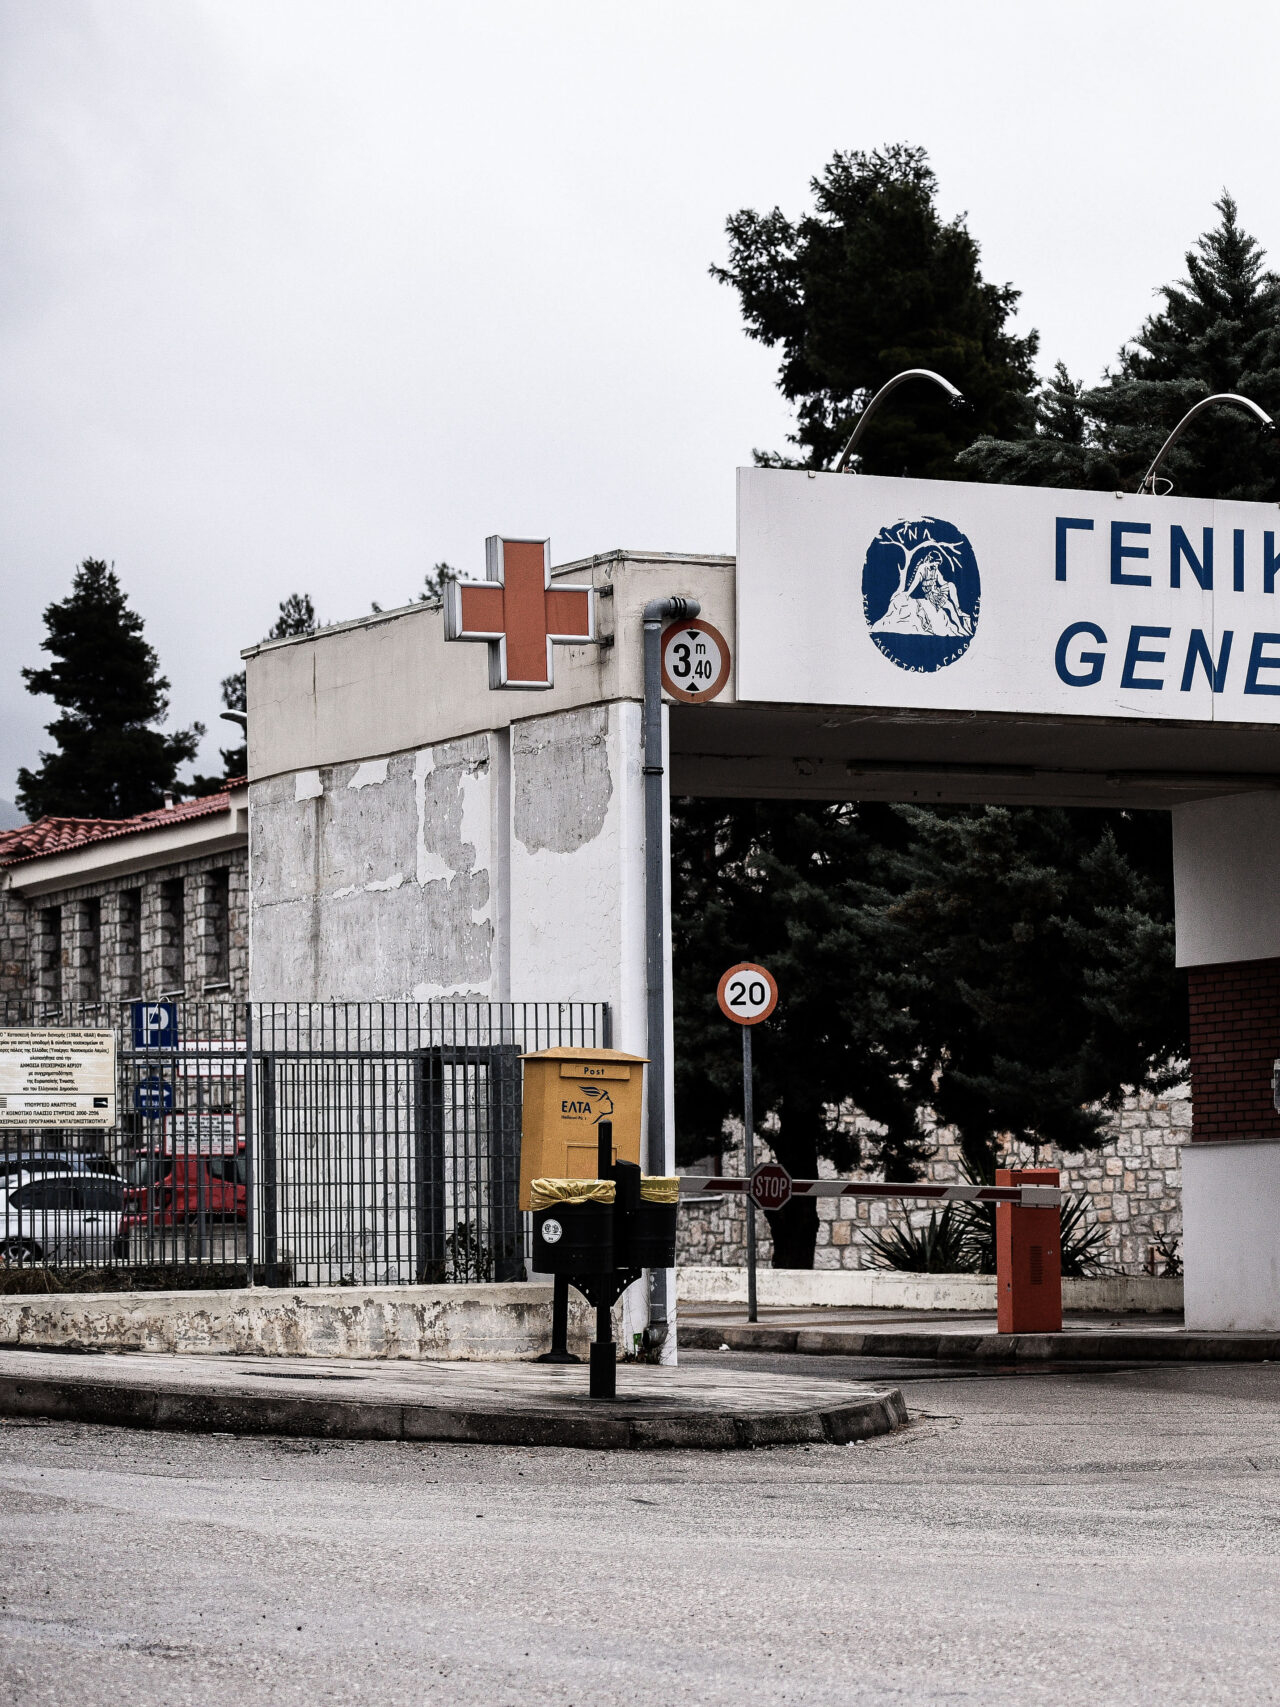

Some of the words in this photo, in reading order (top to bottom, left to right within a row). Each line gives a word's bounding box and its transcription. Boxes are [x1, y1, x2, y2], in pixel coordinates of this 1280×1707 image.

[730, 981, 765, 1006] 20
[142, 1006, 169, 1045] P
[583, 1066, 605, 1075] Post
[561, 1100, 592, 1114] ΕΛΤΑ
[755, 1175, 788, 1198] STOP
